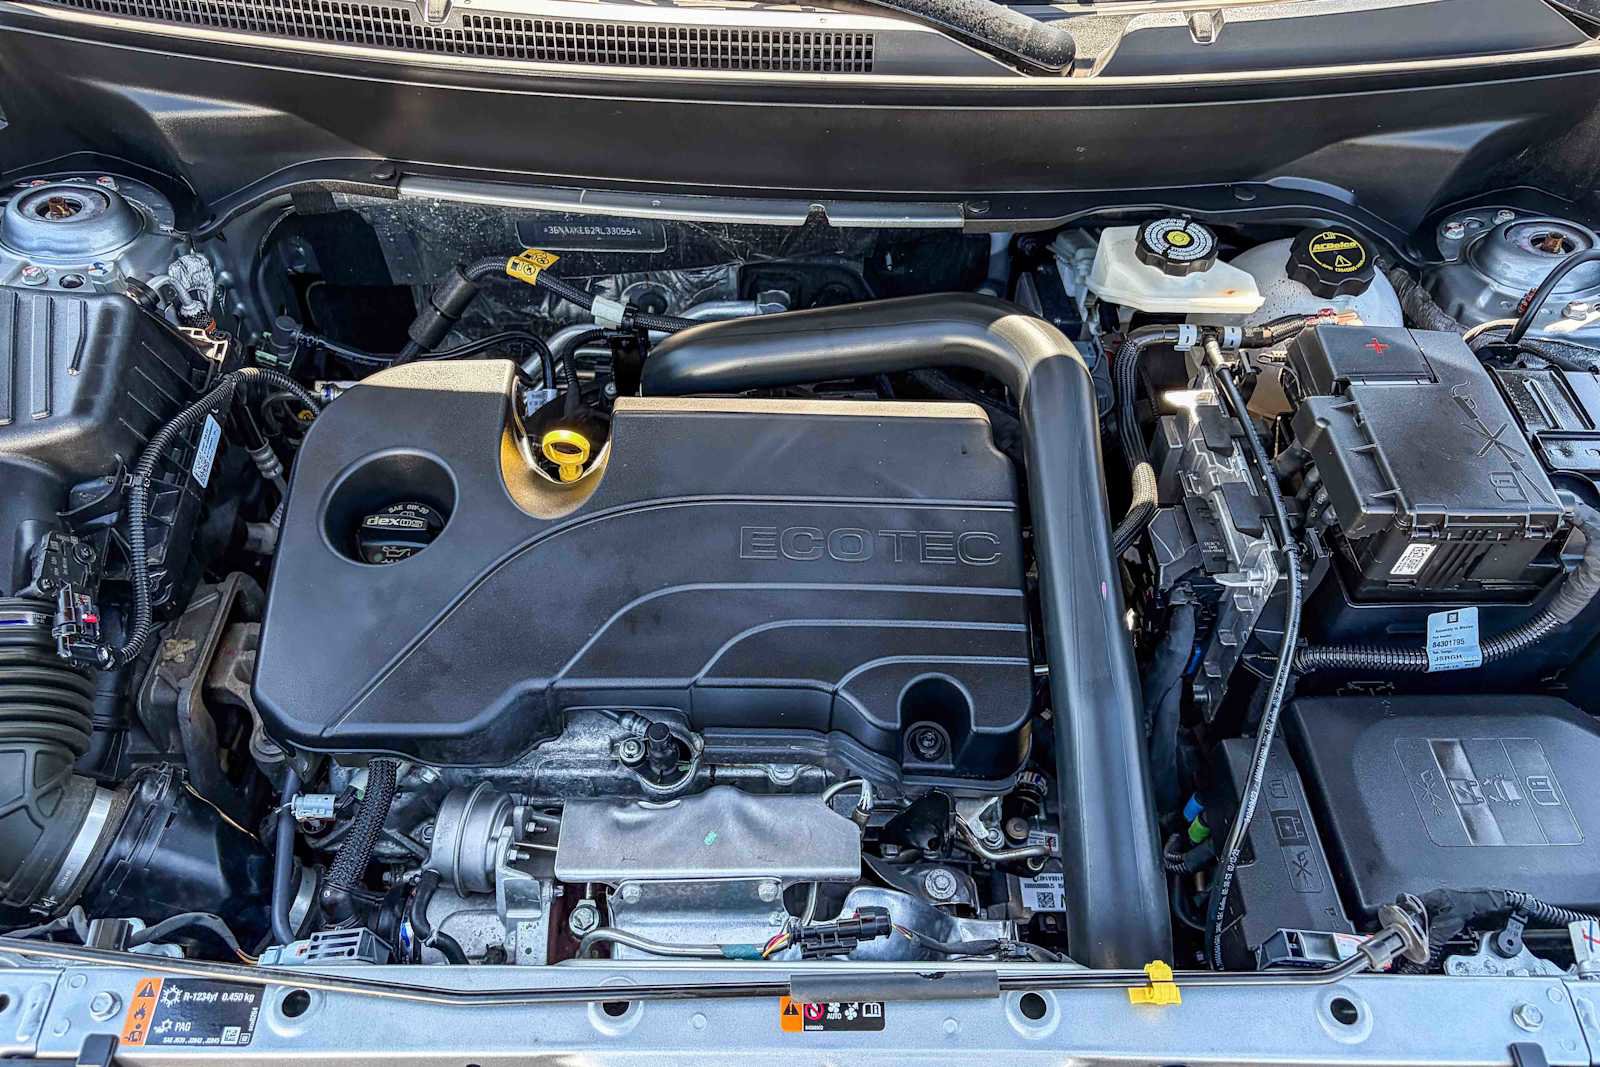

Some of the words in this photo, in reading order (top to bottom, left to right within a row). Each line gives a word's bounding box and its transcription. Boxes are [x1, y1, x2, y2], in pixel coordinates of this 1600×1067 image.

[1312, 241, 1359, 251] ACDelco
[366, 516, 424, 528] dexos
[740, 526, 1001, 566] ECOTEC
[183, 992, 218, 1003] R-1234yf
[221, 992, 244, 1002] 0.450
[244, 992, 255, 1003] kg
[174, 1021, 192, 1032] PAG
